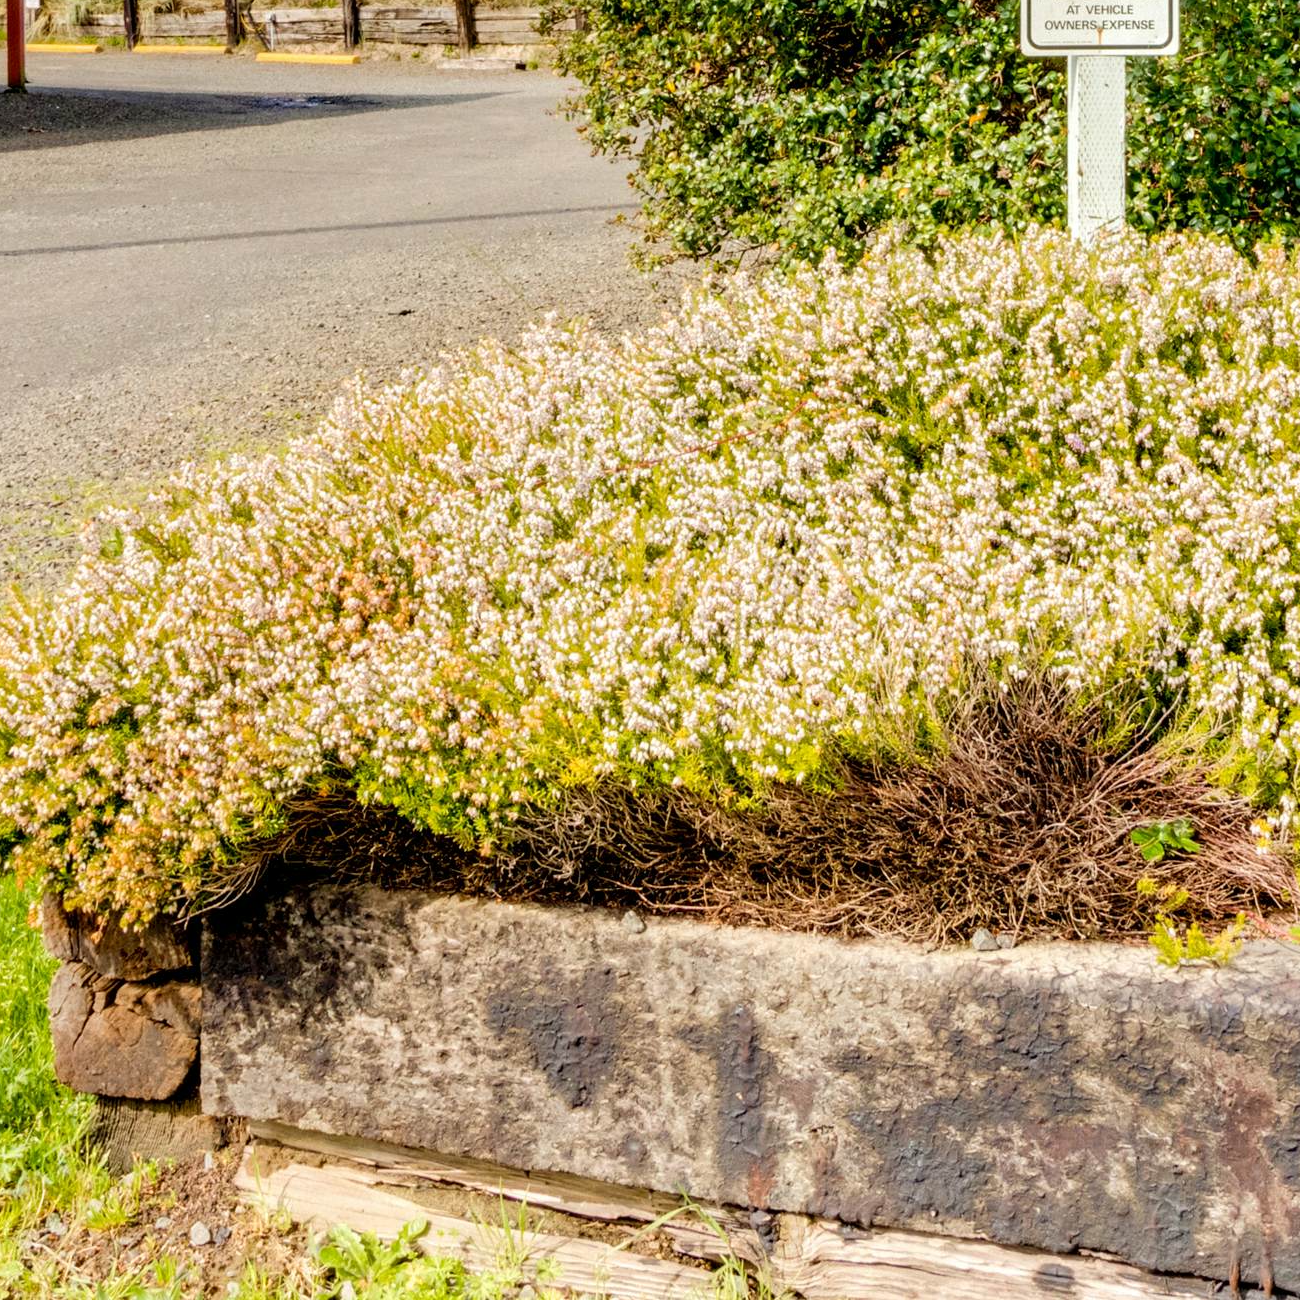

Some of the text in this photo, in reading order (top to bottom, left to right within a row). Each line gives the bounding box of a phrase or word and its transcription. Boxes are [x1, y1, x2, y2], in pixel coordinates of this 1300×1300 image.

[1066, 4, 1134, 15] AT VEHICLE
[1044, 19, 1155, 30] OWNERS EXPENSE
